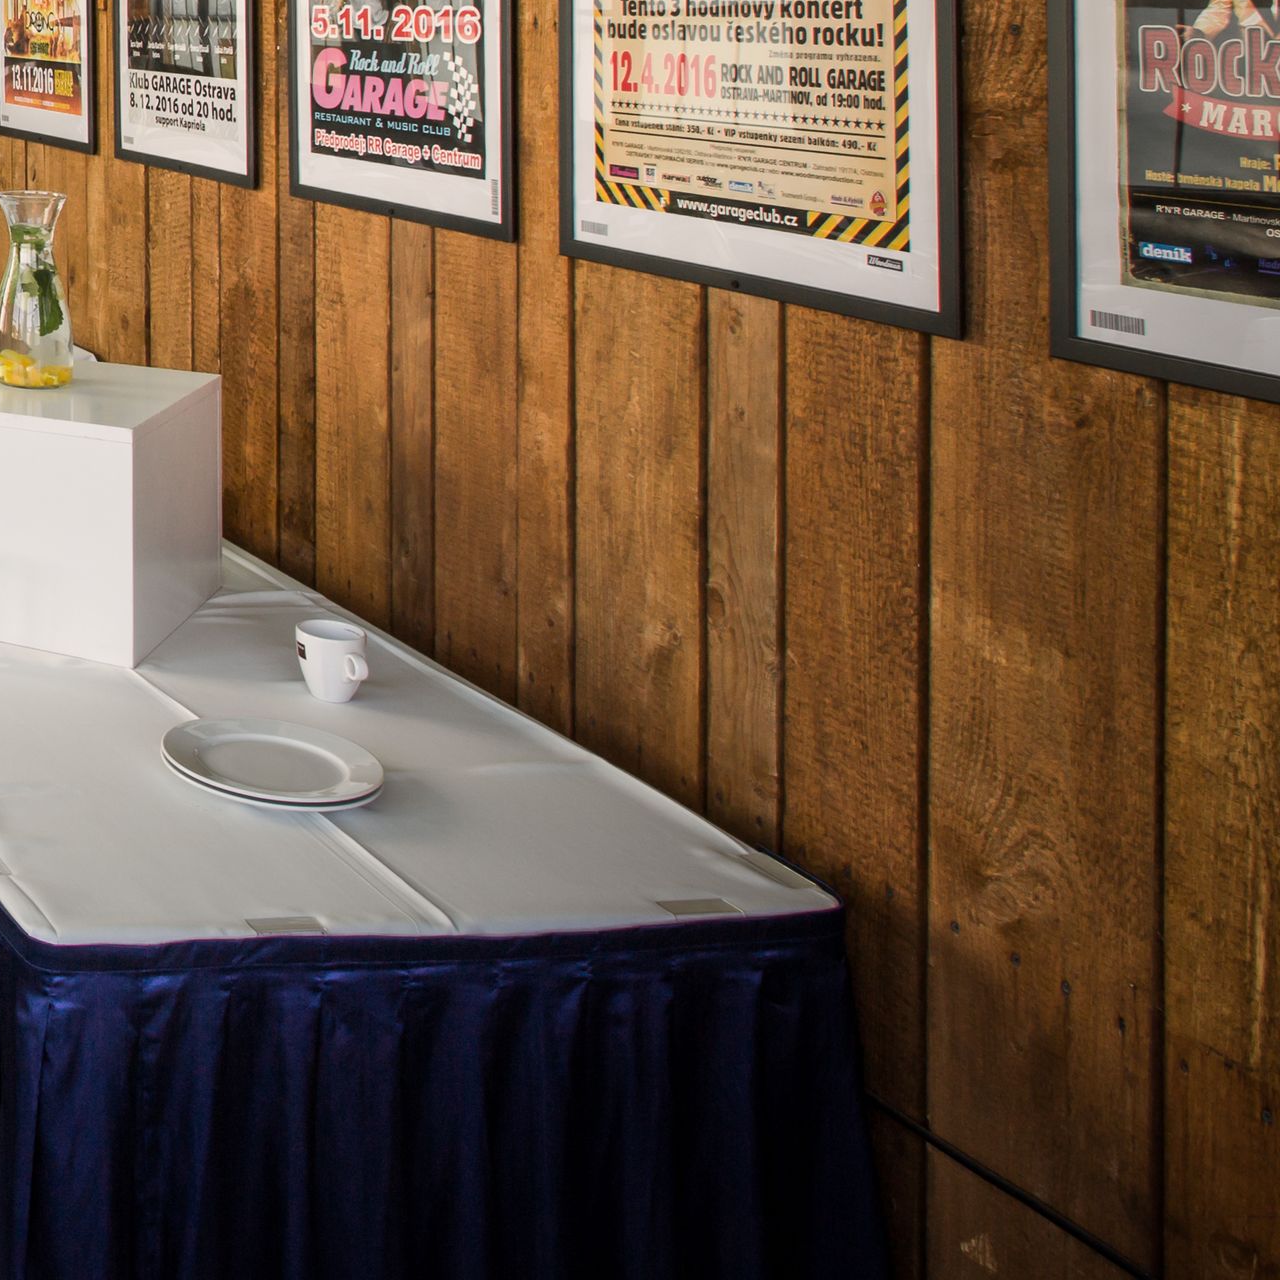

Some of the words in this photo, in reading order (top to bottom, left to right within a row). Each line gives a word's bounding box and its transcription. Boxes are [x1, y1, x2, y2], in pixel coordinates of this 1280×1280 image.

[311, 5, 385, 40] 5.11.
[392, 5, 482, 44] 2016
[608, 19, 647, 40] bude
[652, 20, 722, 42] oslavou
[727, 19, 807, 45] českého
[812, 22, 883, 48] rocku!
[349, 49, 380, 72] Rock
[380, 52, 407, 74] and
[407, 53, 440, 76] Roll
[721, 63, 753, 84] ROCK
[757, 65, 784, 86] AND
[789, 66, 821, 88] ROLL
[826, 68, 886, 91] GARAGE
[12, 65, 54, 95] 13.11.2016
[129, 72, 149, 89] Klub
[151, 75, 192, 95] GARAGE
[194, 80, 236, 101] Ostrava
[312, 47, 449, 121] GARAGE
[130, 92, 138, 108] 8.
[140, 94, 153, 111] 12.
[155, 96, 179, 114] 2016
[181, 99, 194, 116] od
[196, 101, 209, 119] 20
[211, 102, 236, 122] hod.
[720, 86, 813, 107] OSTRAVA-MARTINOV,
[816, 92, 827, 107] od
[830, 93, 860, 109] 19:00
[863, 95, 886, 111] hod.
[155, 115, 179, 128] support
[179, 118, 206, 131] Kapriola
[314, 112, 372, 127] RESTAURANT
[375, 118, 383, 128] &
[387, 120, 418, 133] MUSIC
[422, 125, 451, 137] CLUB
[1199, 100, 1280, 137] MAR
[315, 128, 366, 156] Předprodej:
[367, 137, 382, 155] RR
[383, 138, 421, 164] Garage
[431, 144, 482, 170] Centrum
[724, 128, 736, 138] VIP
[738, 131, 778, 143] vstupenky
[779, 134, 806, 144] sezení
[866, 141, 877, 152] Kč
[676, 196, 798, 227] www.garageclub.cz
[1183, 207, 1225, 219] GARAGE
